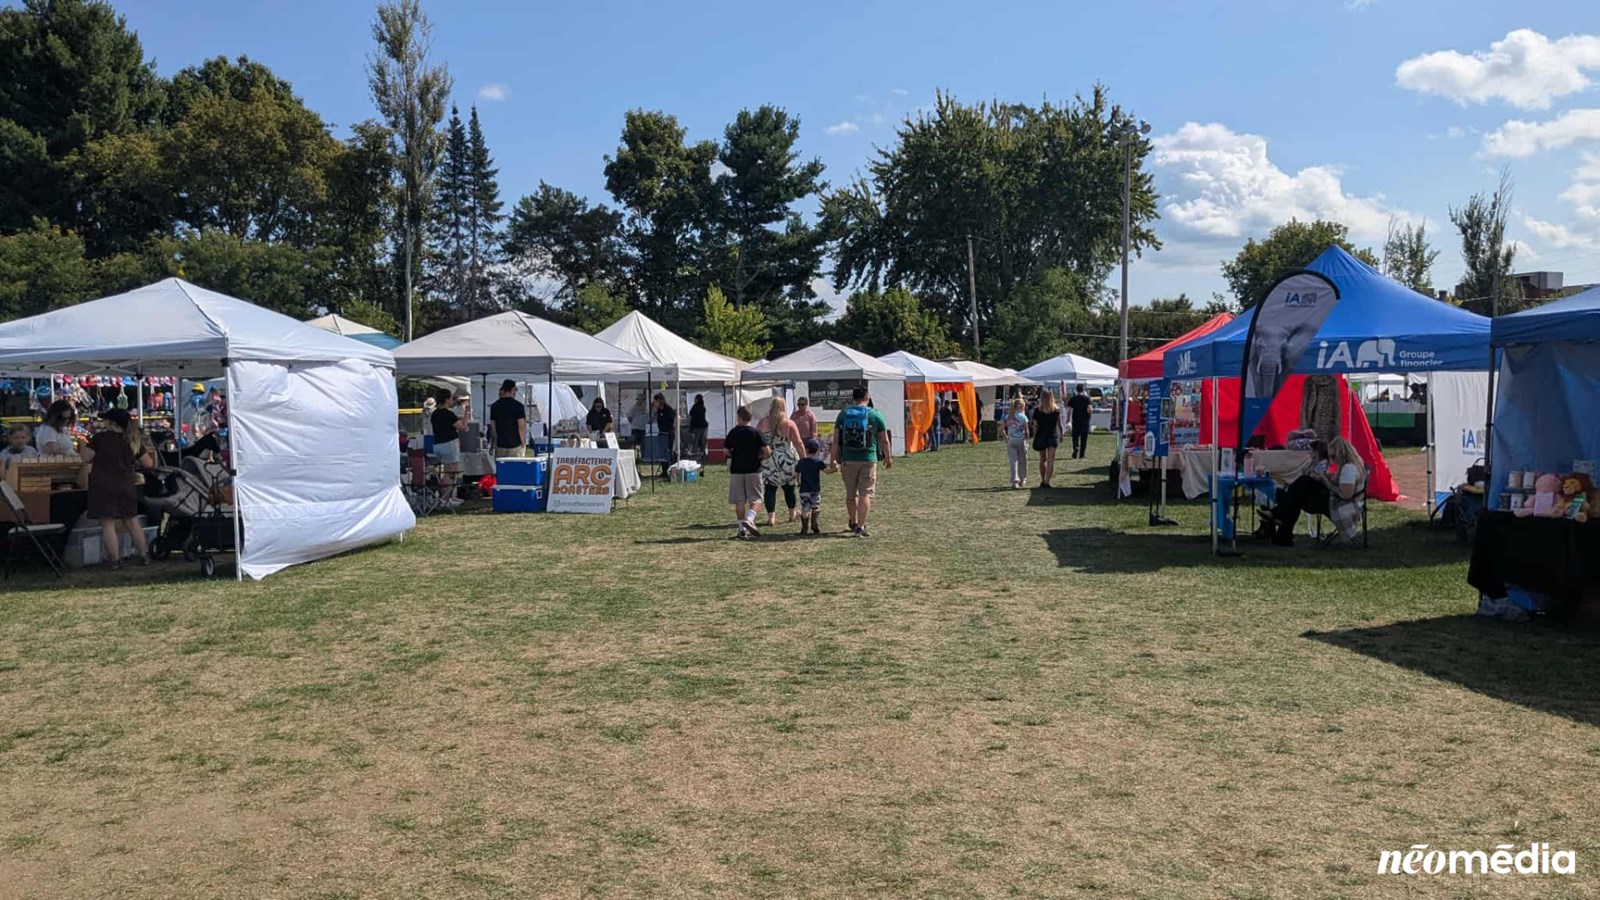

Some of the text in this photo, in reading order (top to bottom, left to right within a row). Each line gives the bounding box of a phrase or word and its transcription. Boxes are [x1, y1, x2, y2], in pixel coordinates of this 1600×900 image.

[1316, 340, 1355, 369] iA
[1399, 350, 1436, 360] Groupe
[1462, 428, 1476, 449] iA
[553, 464, 612, 486] ARC
